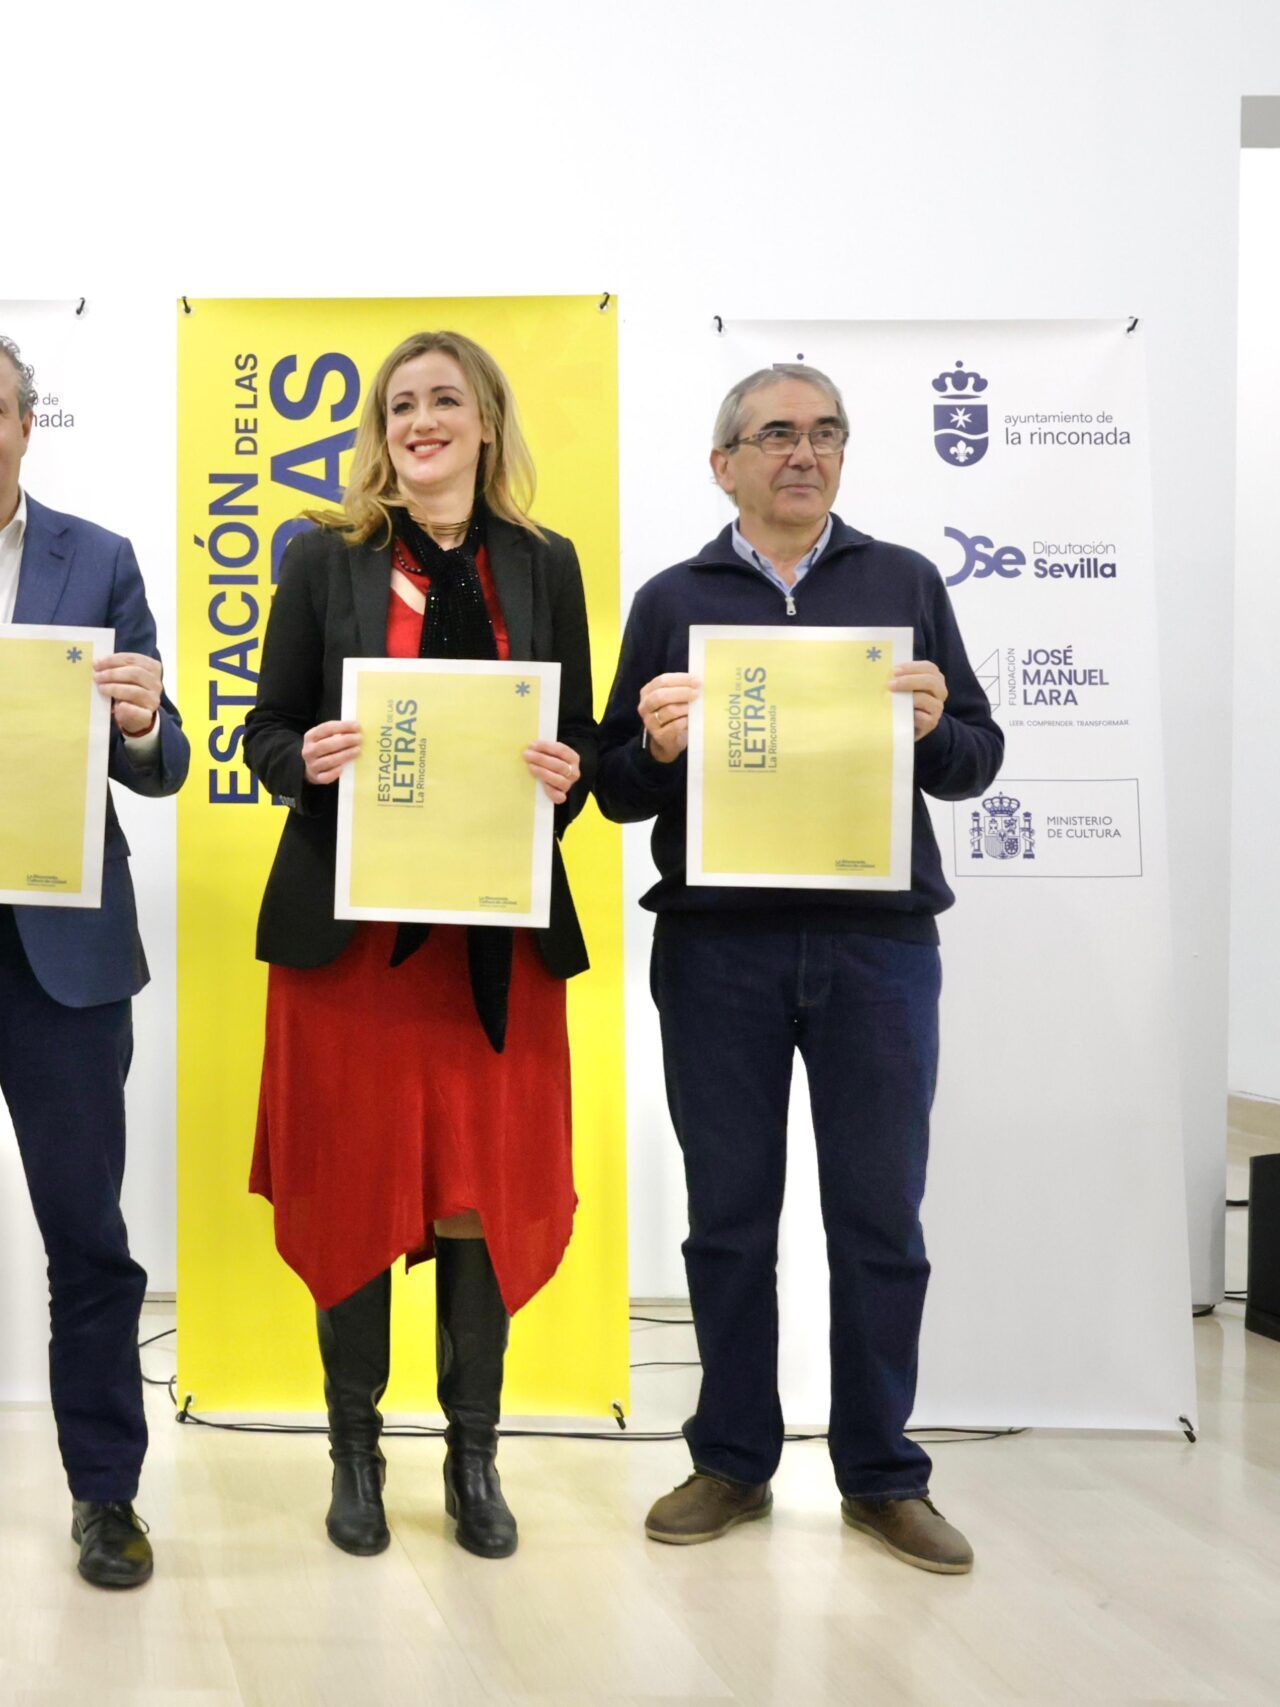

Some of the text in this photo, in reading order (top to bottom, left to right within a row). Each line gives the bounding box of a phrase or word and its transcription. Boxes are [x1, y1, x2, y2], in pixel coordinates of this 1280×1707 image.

[42, 393, 59, 406] de
[1004, 411, 1114, 427] ayuntamiento de
[1005, 427, 1132, 446] la rinconada
[1032, 540, 1117, 557] Diputación
[193, 353, 259, 805] ESTACIÓN DE LAS
[1033, 558, 1117, 579] Sevilla
[1022, 645, 1074, 666] JOSÉ
[1007, 648, 1017, 706] FUNDACIÓN
[1022, 669, 1110, 686] MANUEL
[1022, 689, 1079, 706] LARA
[743, 667, 767, 769] LETRAS
[727, 694, 741, 768] ESTACIÓN
[768, 705, 777, 768] La Rinconada
[392, 699, 418, 804] LETRAS
[378, 726, 393, 803] ESTACIÓN
[416, 738, 427, 804] La Rinconada
[1046, 816, 1113, 826] MINISTERIO
[1047, 828, 1122, 839] DE CULTURA
